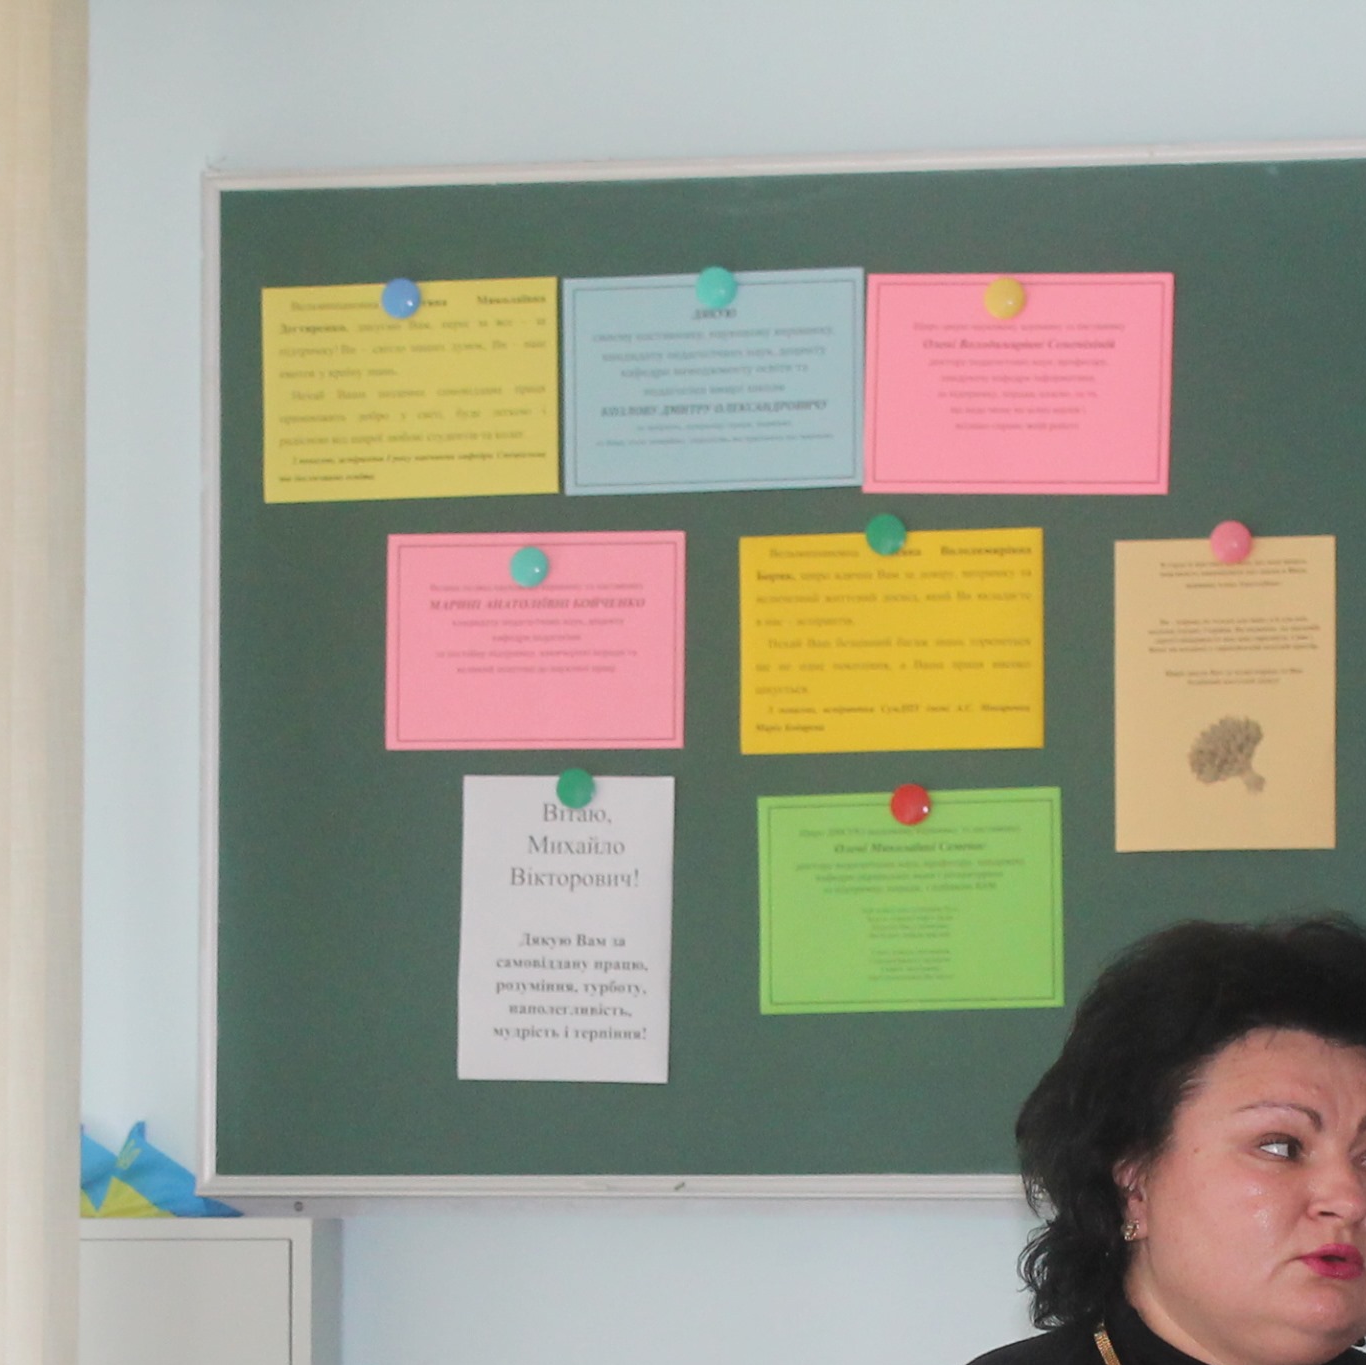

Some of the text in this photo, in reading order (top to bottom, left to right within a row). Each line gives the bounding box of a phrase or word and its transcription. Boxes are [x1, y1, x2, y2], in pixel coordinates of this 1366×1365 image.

[528, 836, 625, 856] Михайло
[509, 867, 639, 892] Вікторович!
[519, 933, 626, 948] Дякую Вам за
[496, 956, 648, 972] самовіддану працю,
[496, 980, 579, 995] розуміння,
[493, 1026, 647, 1042] мудрість і терпіння!
